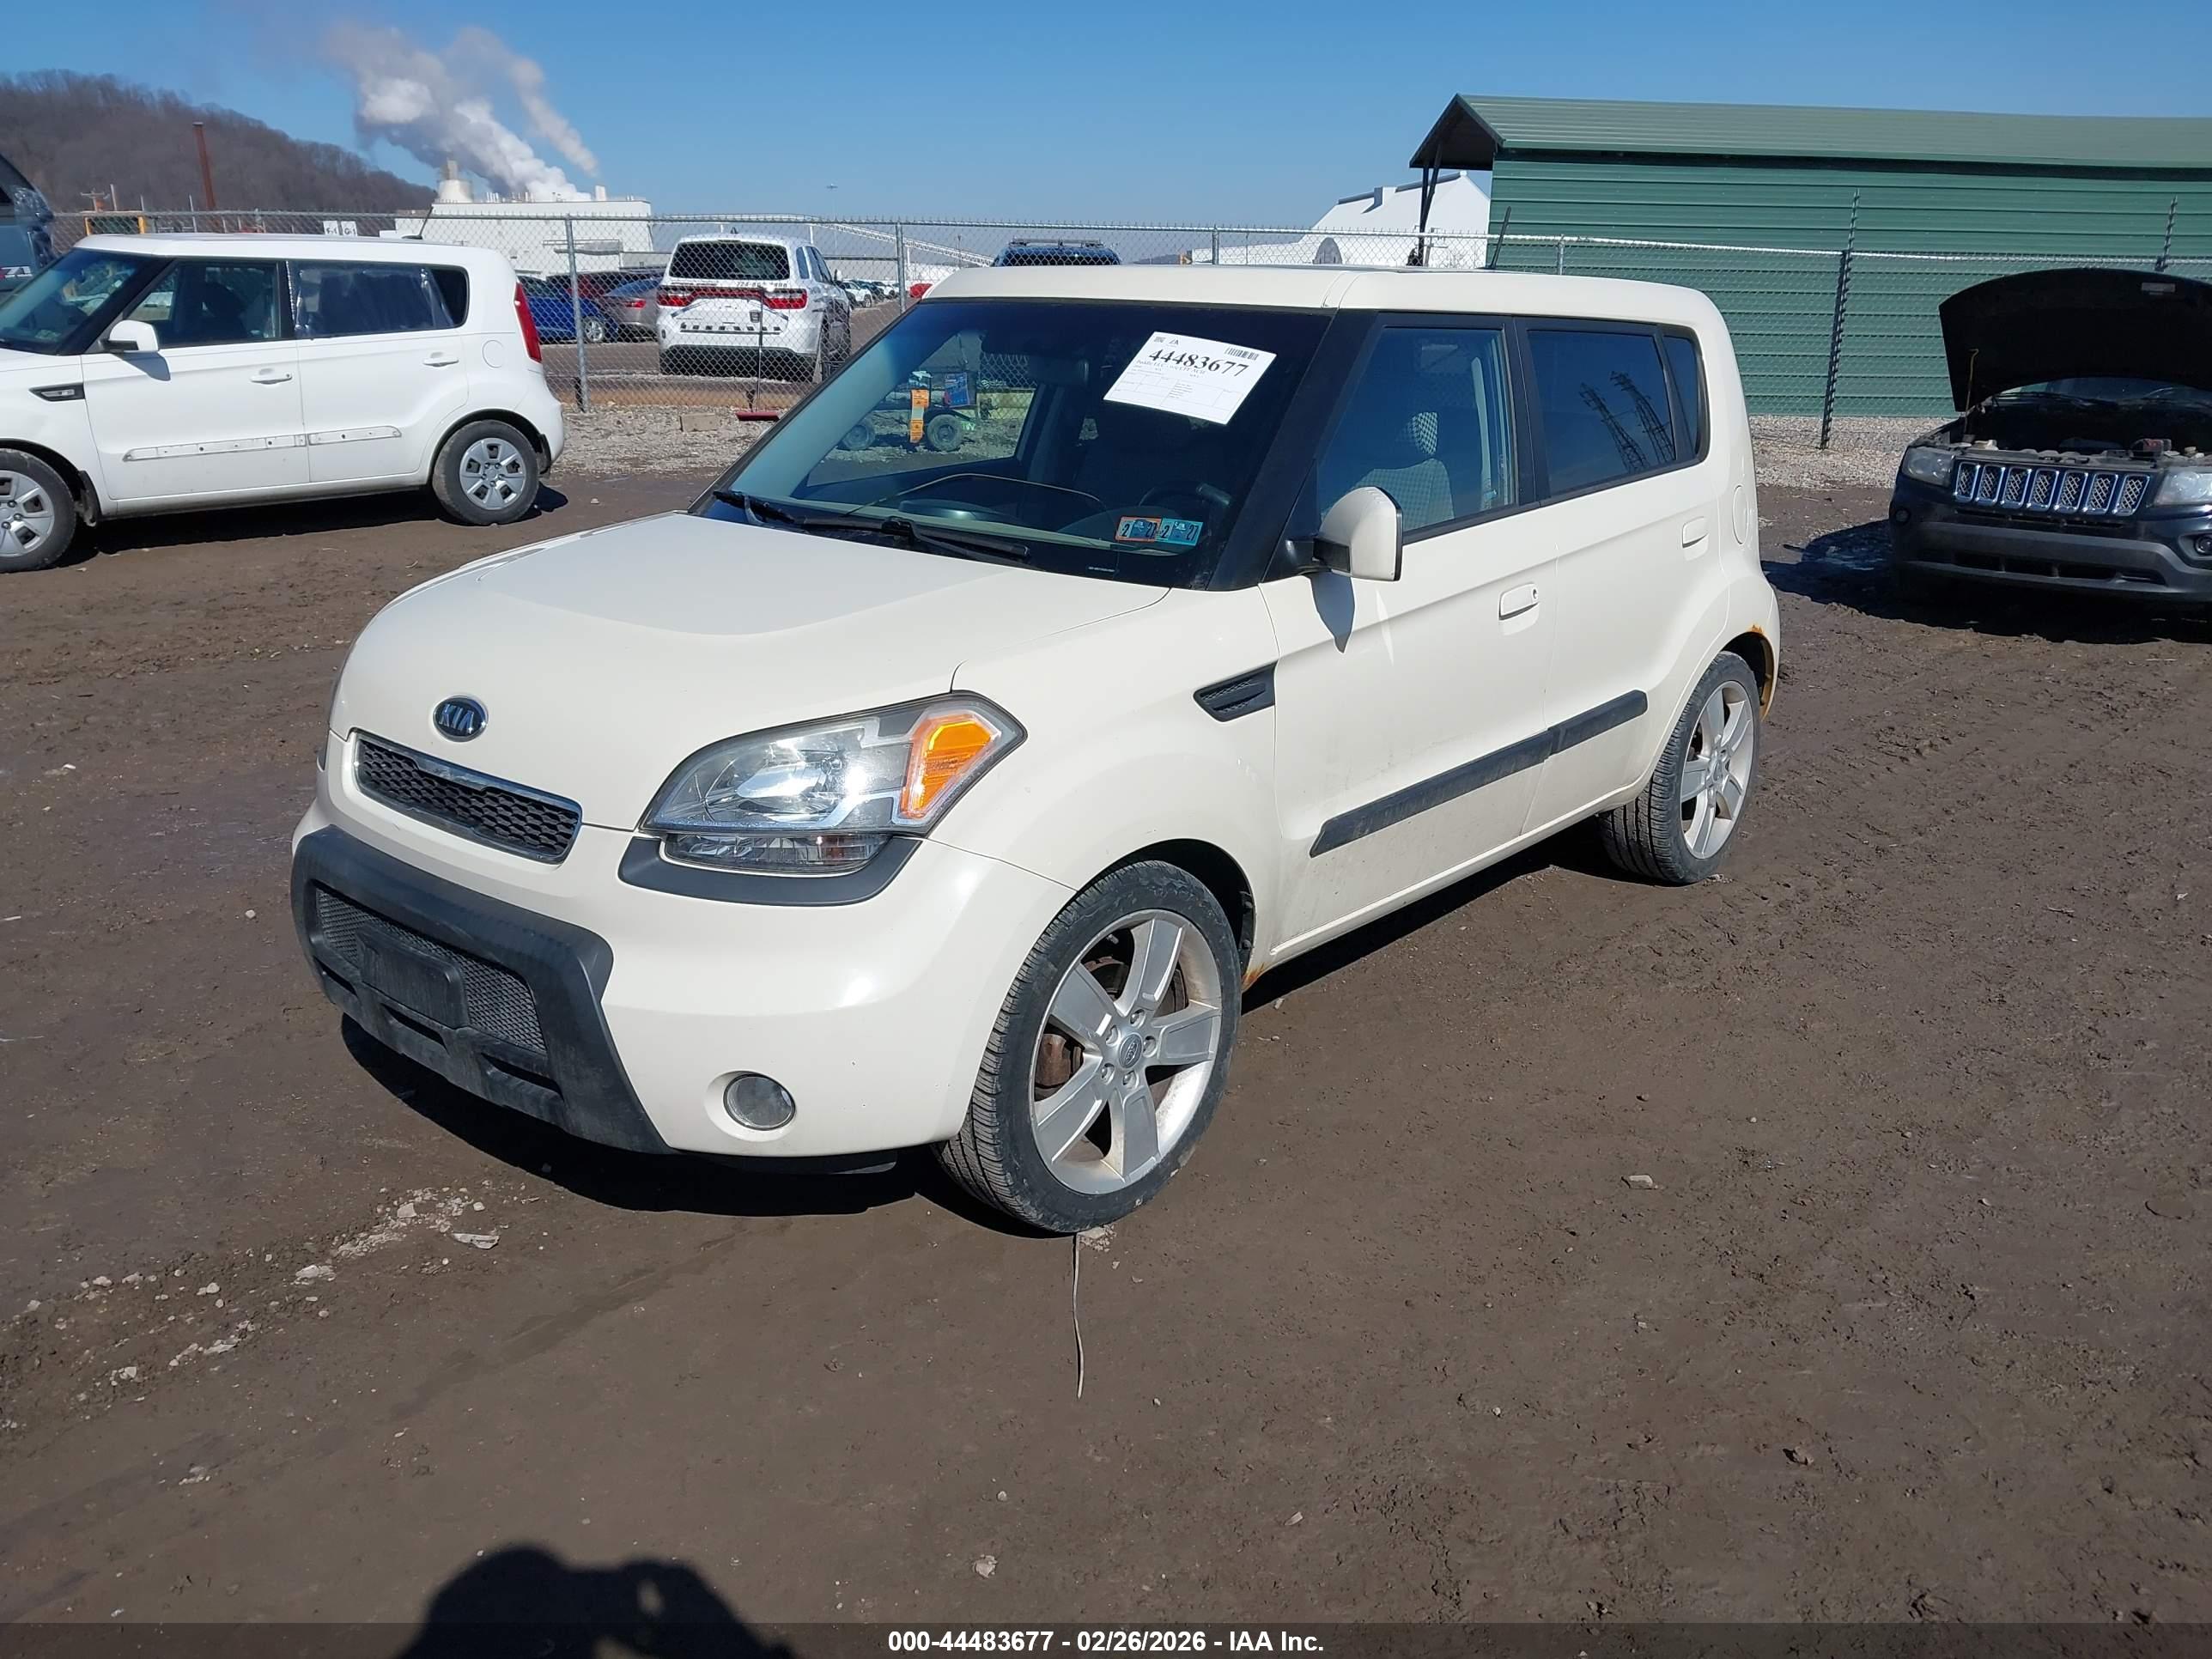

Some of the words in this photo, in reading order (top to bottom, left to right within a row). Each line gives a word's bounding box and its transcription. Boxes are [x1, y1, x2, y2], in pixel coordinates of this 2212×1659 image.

[1149, 349, 1249, 377] 44483677
[1121, 523, 1130, 538] 2
[1161, 525, 1170, 538] 2
[1187, 524, 1199, 541] 27
[438, 703, 474, 734] KIA
